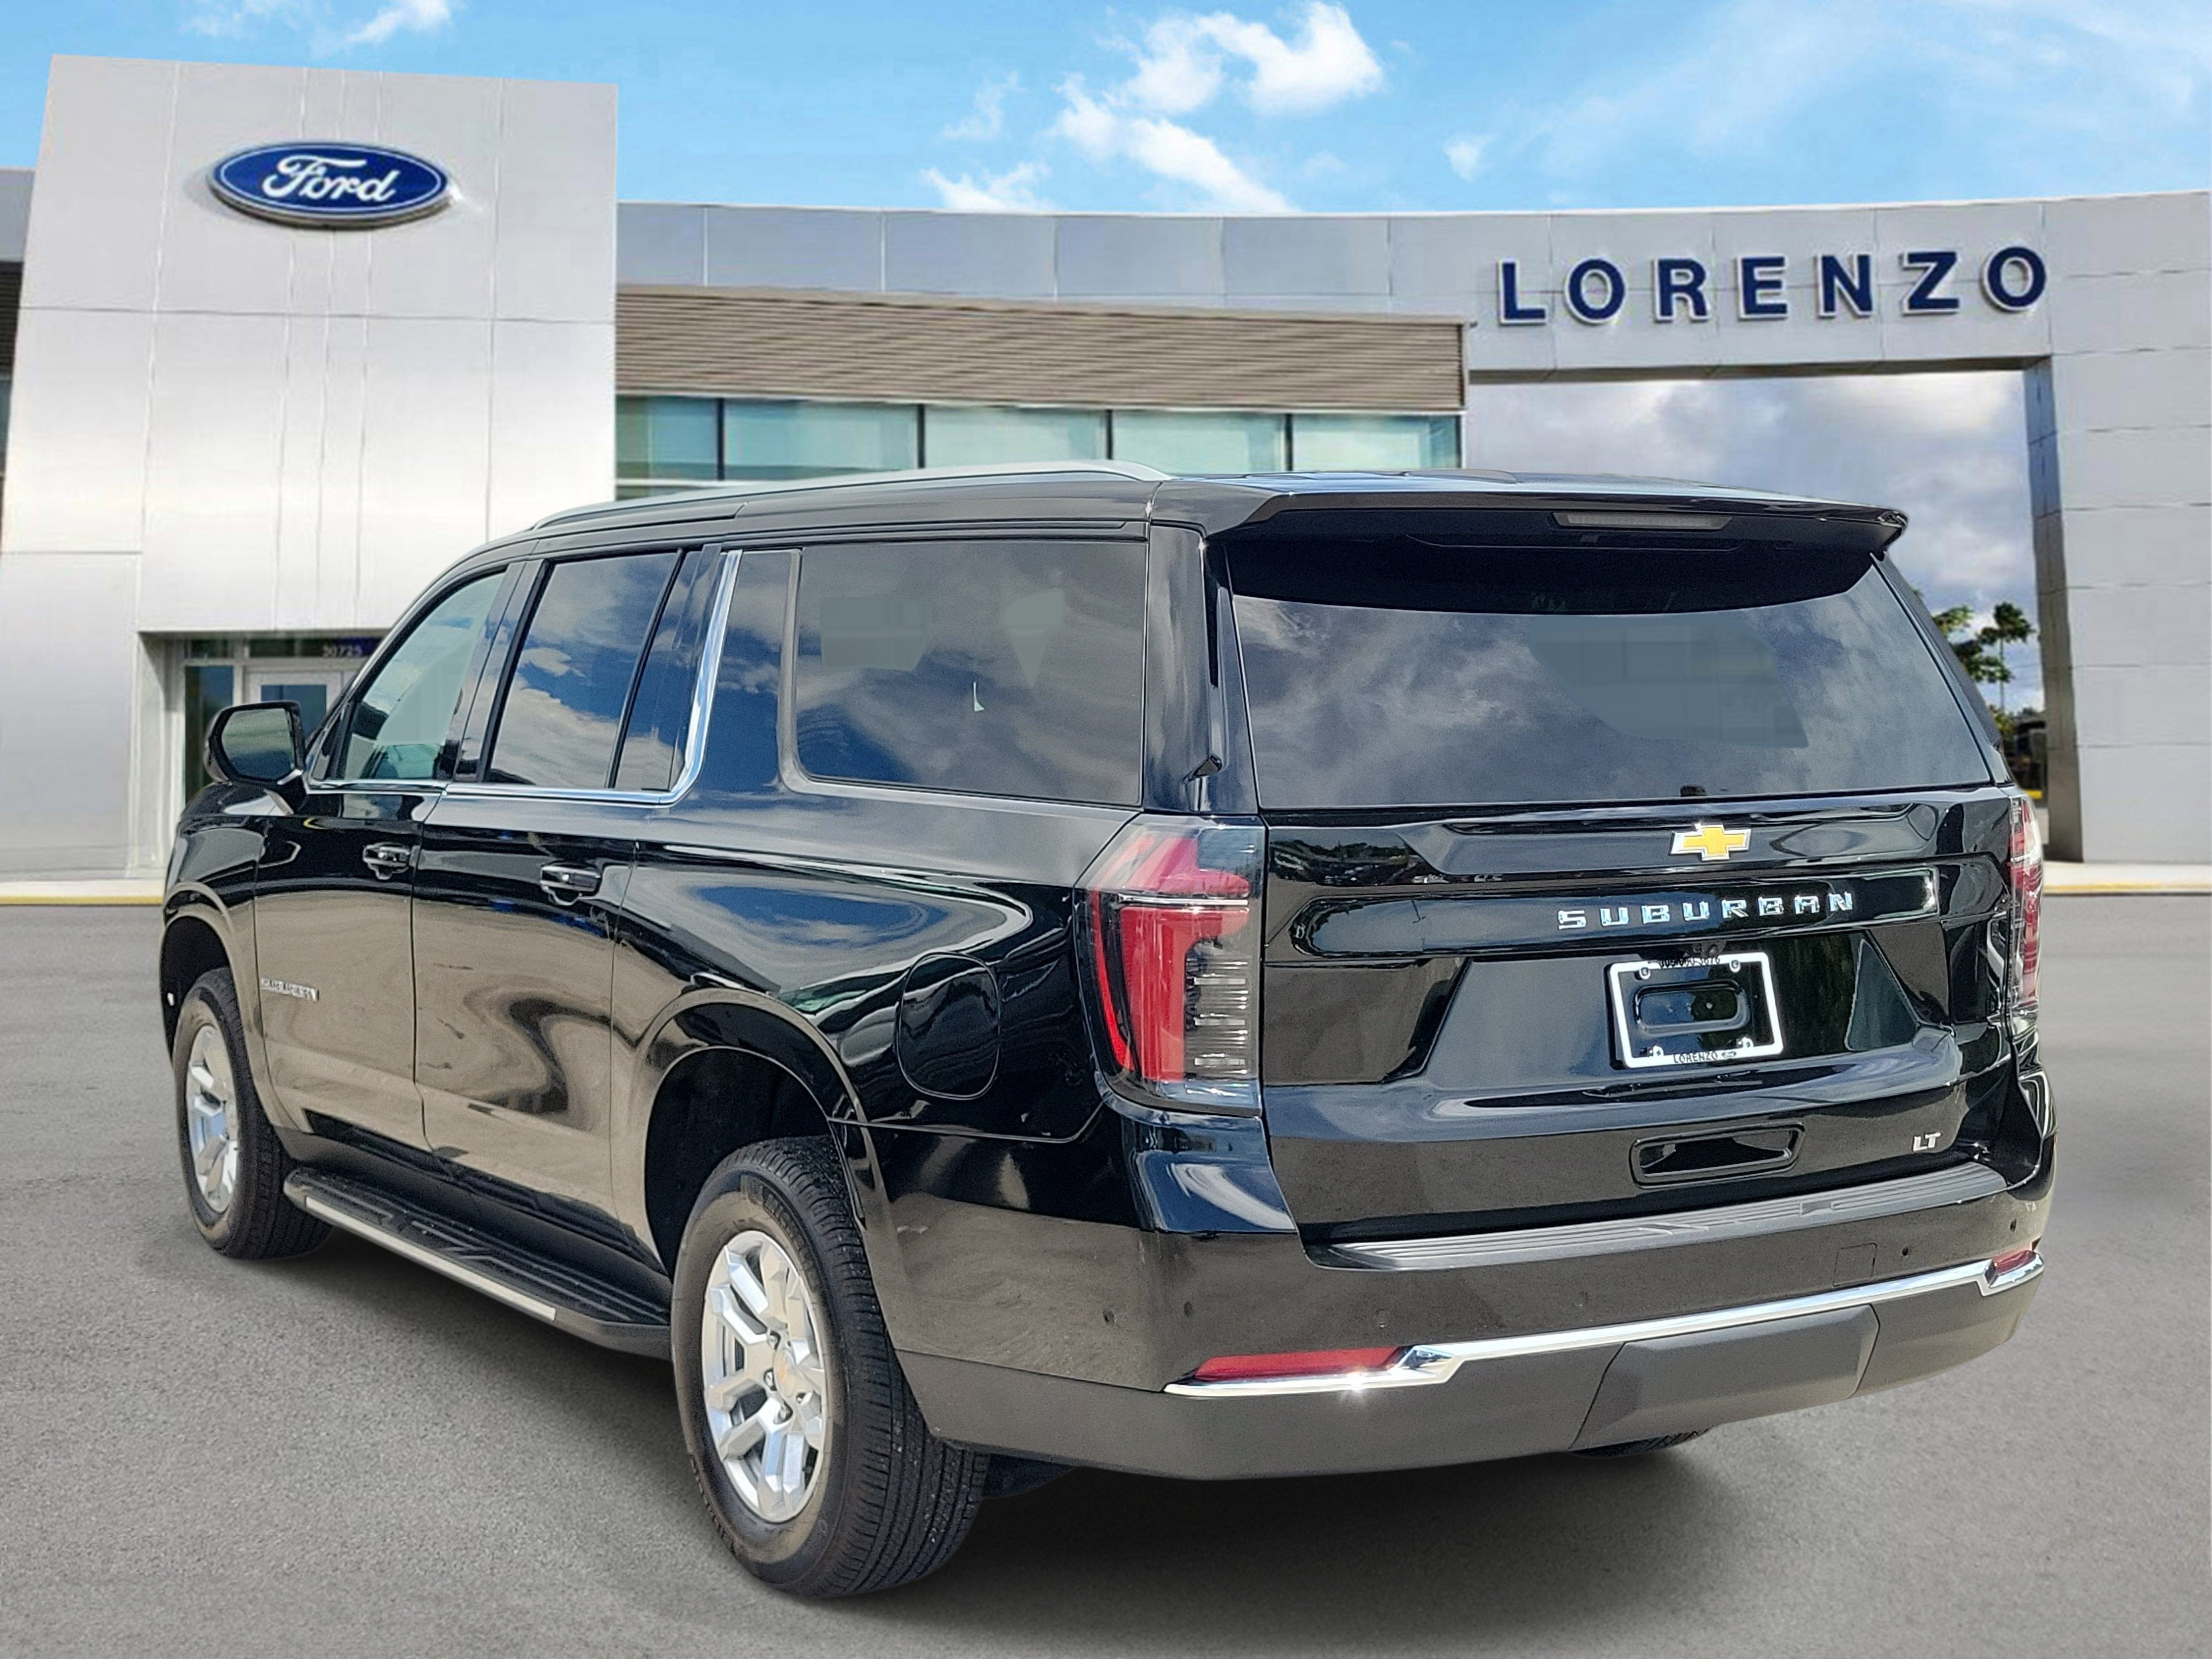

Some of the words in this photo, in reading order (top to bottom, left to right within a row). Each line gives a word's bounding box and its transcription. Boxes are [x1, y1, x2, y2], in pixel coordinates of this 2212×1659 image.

[261, 155, 401, 202] Ford
[1498, 246, 2047, 325] LORENZO
[1557, 892, 1853, 930] SUBURBAN
[1673, 1050, 1718, 1064] LORENZO
[1913, 1132, 1942, 1152] LT
